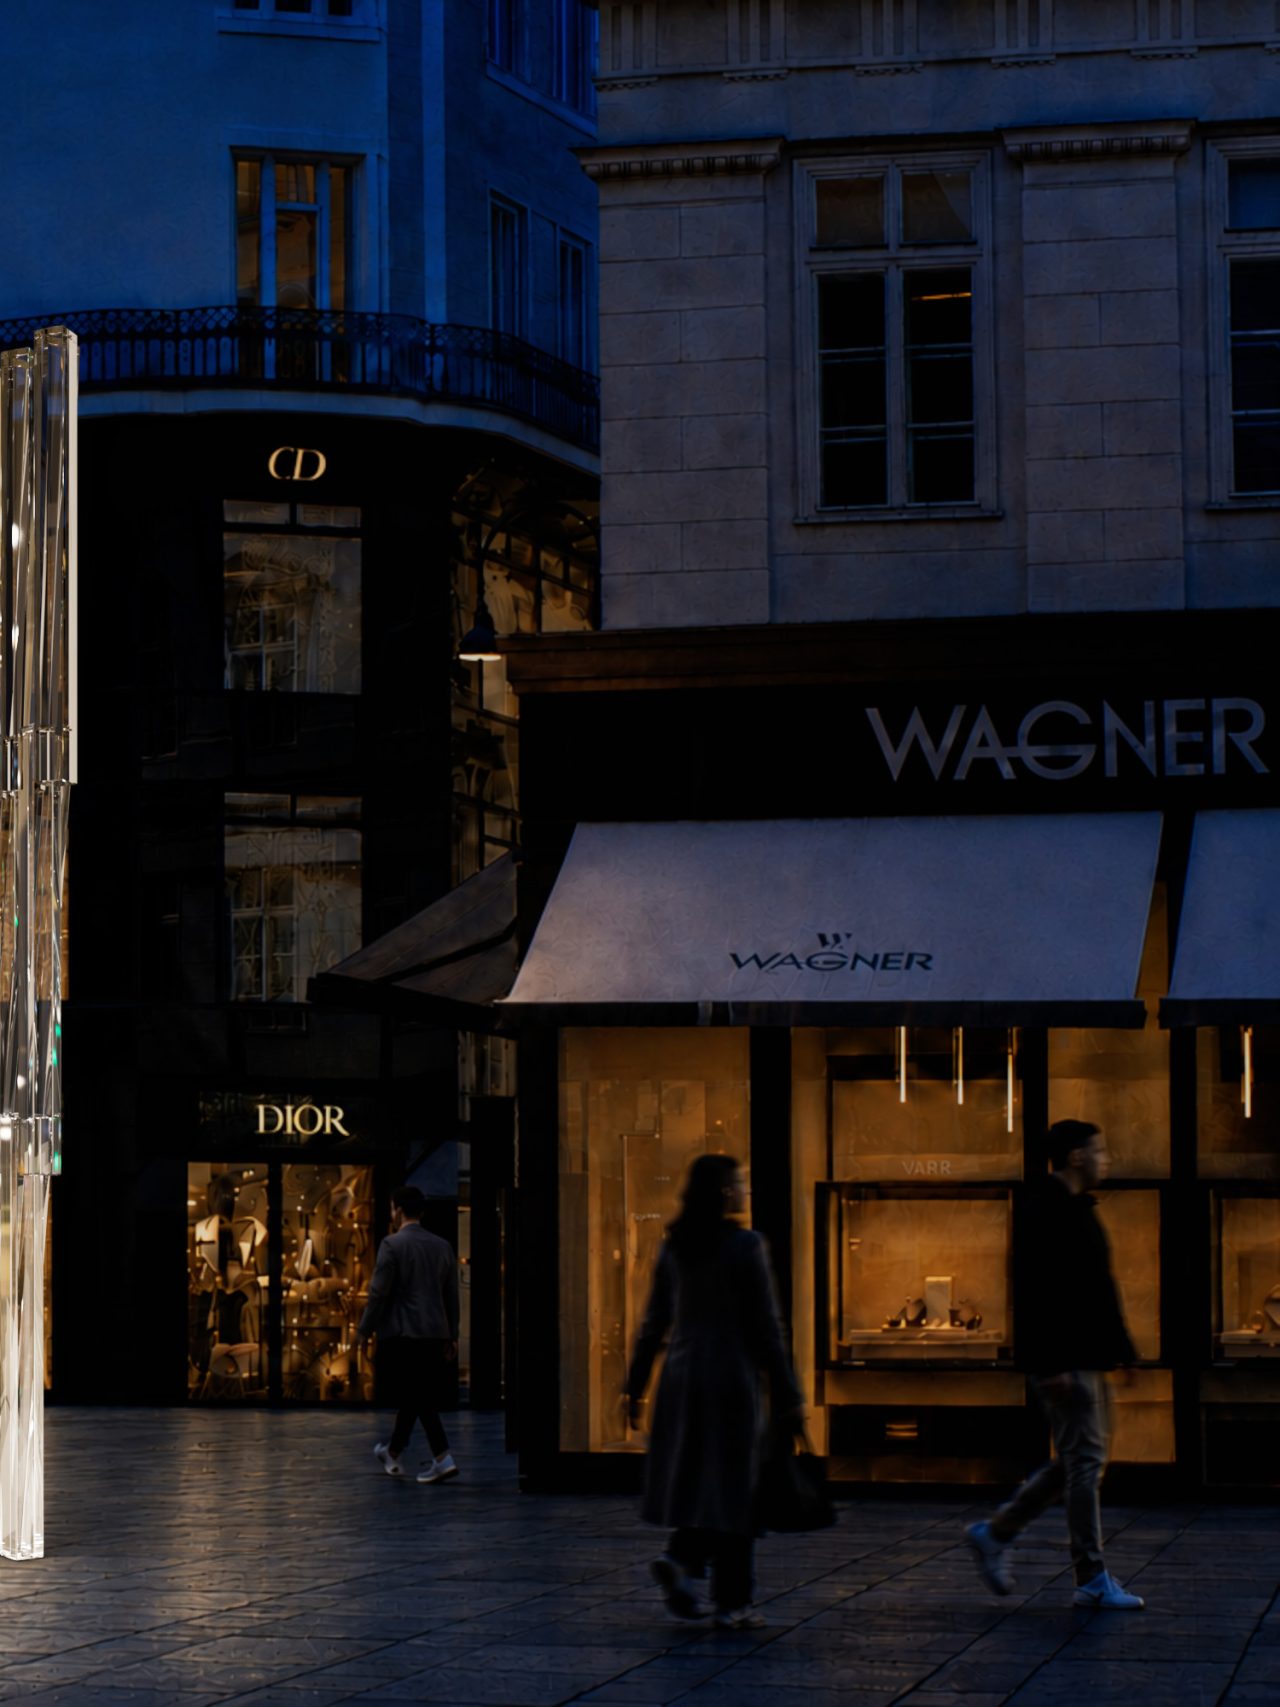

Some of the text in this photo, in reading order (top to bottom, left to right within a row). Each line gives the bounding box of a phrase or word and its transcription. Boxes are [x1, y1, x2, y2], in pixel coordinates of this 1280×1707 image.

[864, 697, 1271, 783] WAGNER
[730, 951, 933, 971] WAGNER
[254, 1103, 351, 1136] DIOR
